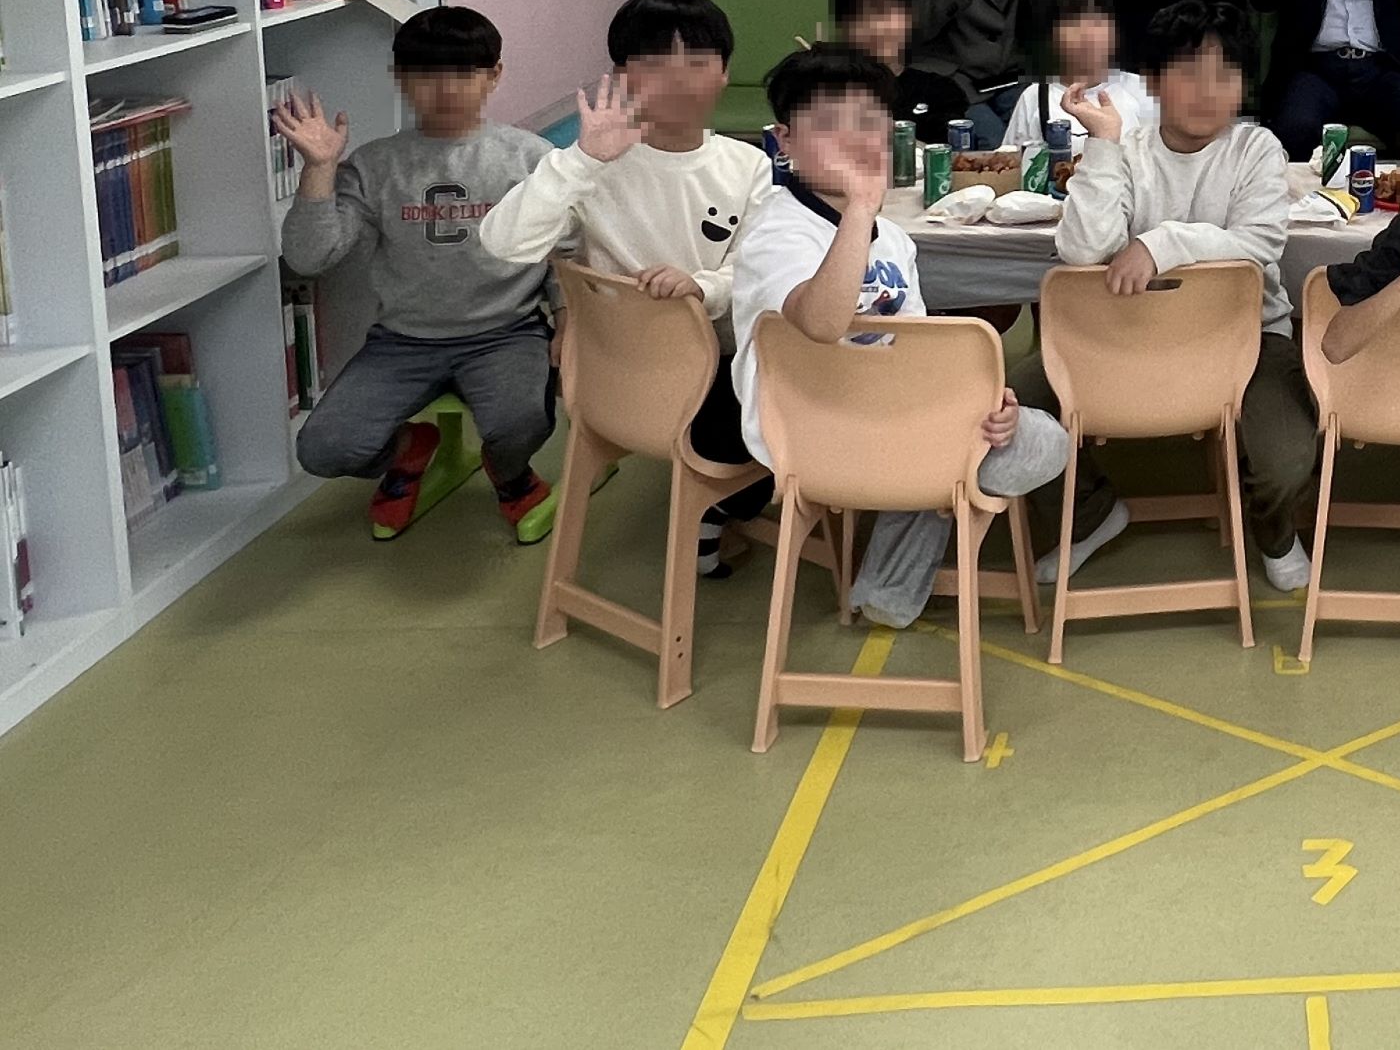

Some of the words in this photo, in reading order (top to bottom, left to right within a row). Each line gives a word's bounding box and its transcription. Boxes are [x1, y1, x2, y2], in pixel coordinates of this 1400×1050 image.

[401, 205, 445, 221] BOOK
[424, 182, 469, 246] C
[1301, 838, 1359, 906] 3
